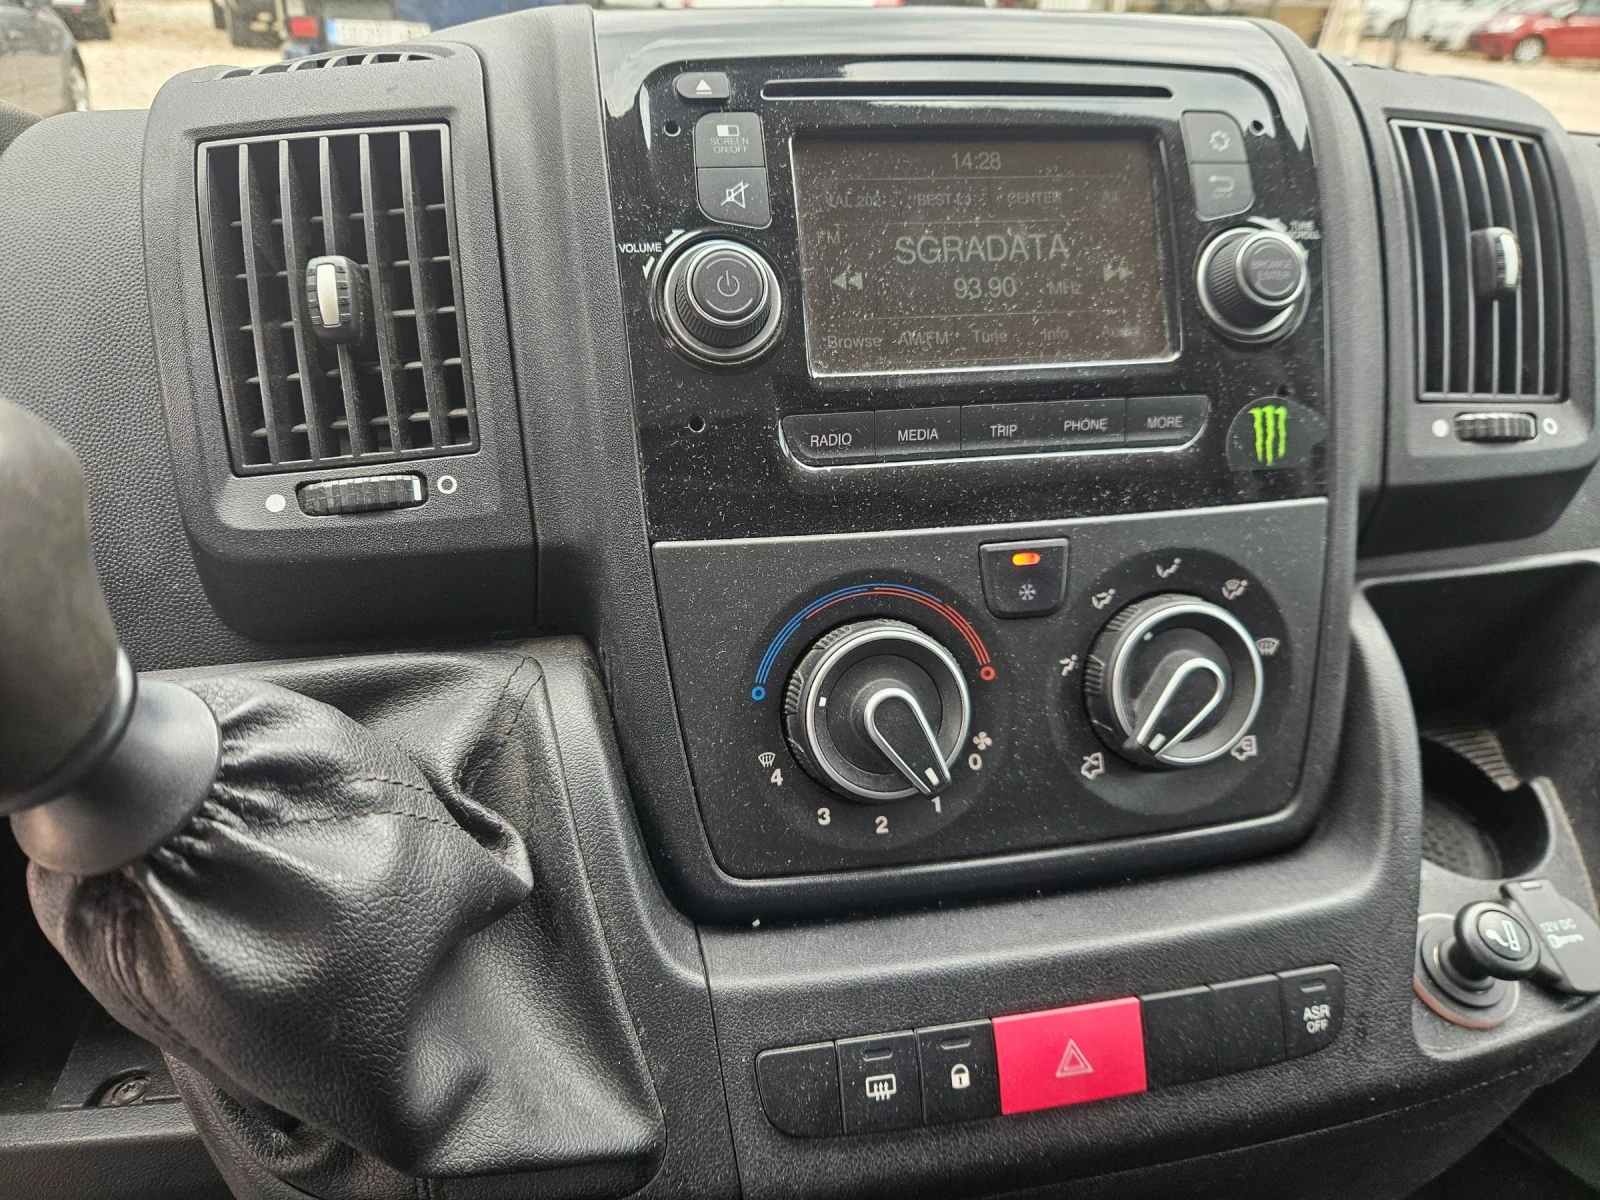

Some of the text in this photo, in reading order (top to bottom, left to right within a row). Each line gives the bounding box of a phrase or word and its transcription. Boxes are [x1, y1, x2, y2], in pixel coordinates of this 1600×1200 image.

[709, 137, 750, 146] SCREEN
[713, 145, 749, 154] ON/OFF
[951, 151, 1001, 171] 14:28
[917, 193, 950, 207] BEST
[618, 242, 663, 254] VOLUME
[895, 233, 1070, 265] SGRADATA
[953, 276, 1083, 299] 93.90 MHz
[972, 329, 1008, 344] Tune
[1042, 326, 1070, 341] Info
[827, 335, 883, 349] Browse
[1063, 417, 1108, 432] PHONE
[1146, 416, 1183, 429] MORE
[897, 428, 939, 442] MEDIA
[989, 424, 1018, 437] TRIP
[810, 432, 853, 448] RADIO
[968, 752, 983, 771] 0
[770, 768, 784, 787] 4
[931, 796, 942, 814] 1
[817, 807, 831, 826] 3
[875, 815, 889, 835] 2
[1303, 1004, 1331, 1022] ASR
[1306, 1019, 1329, 1034] OFF
